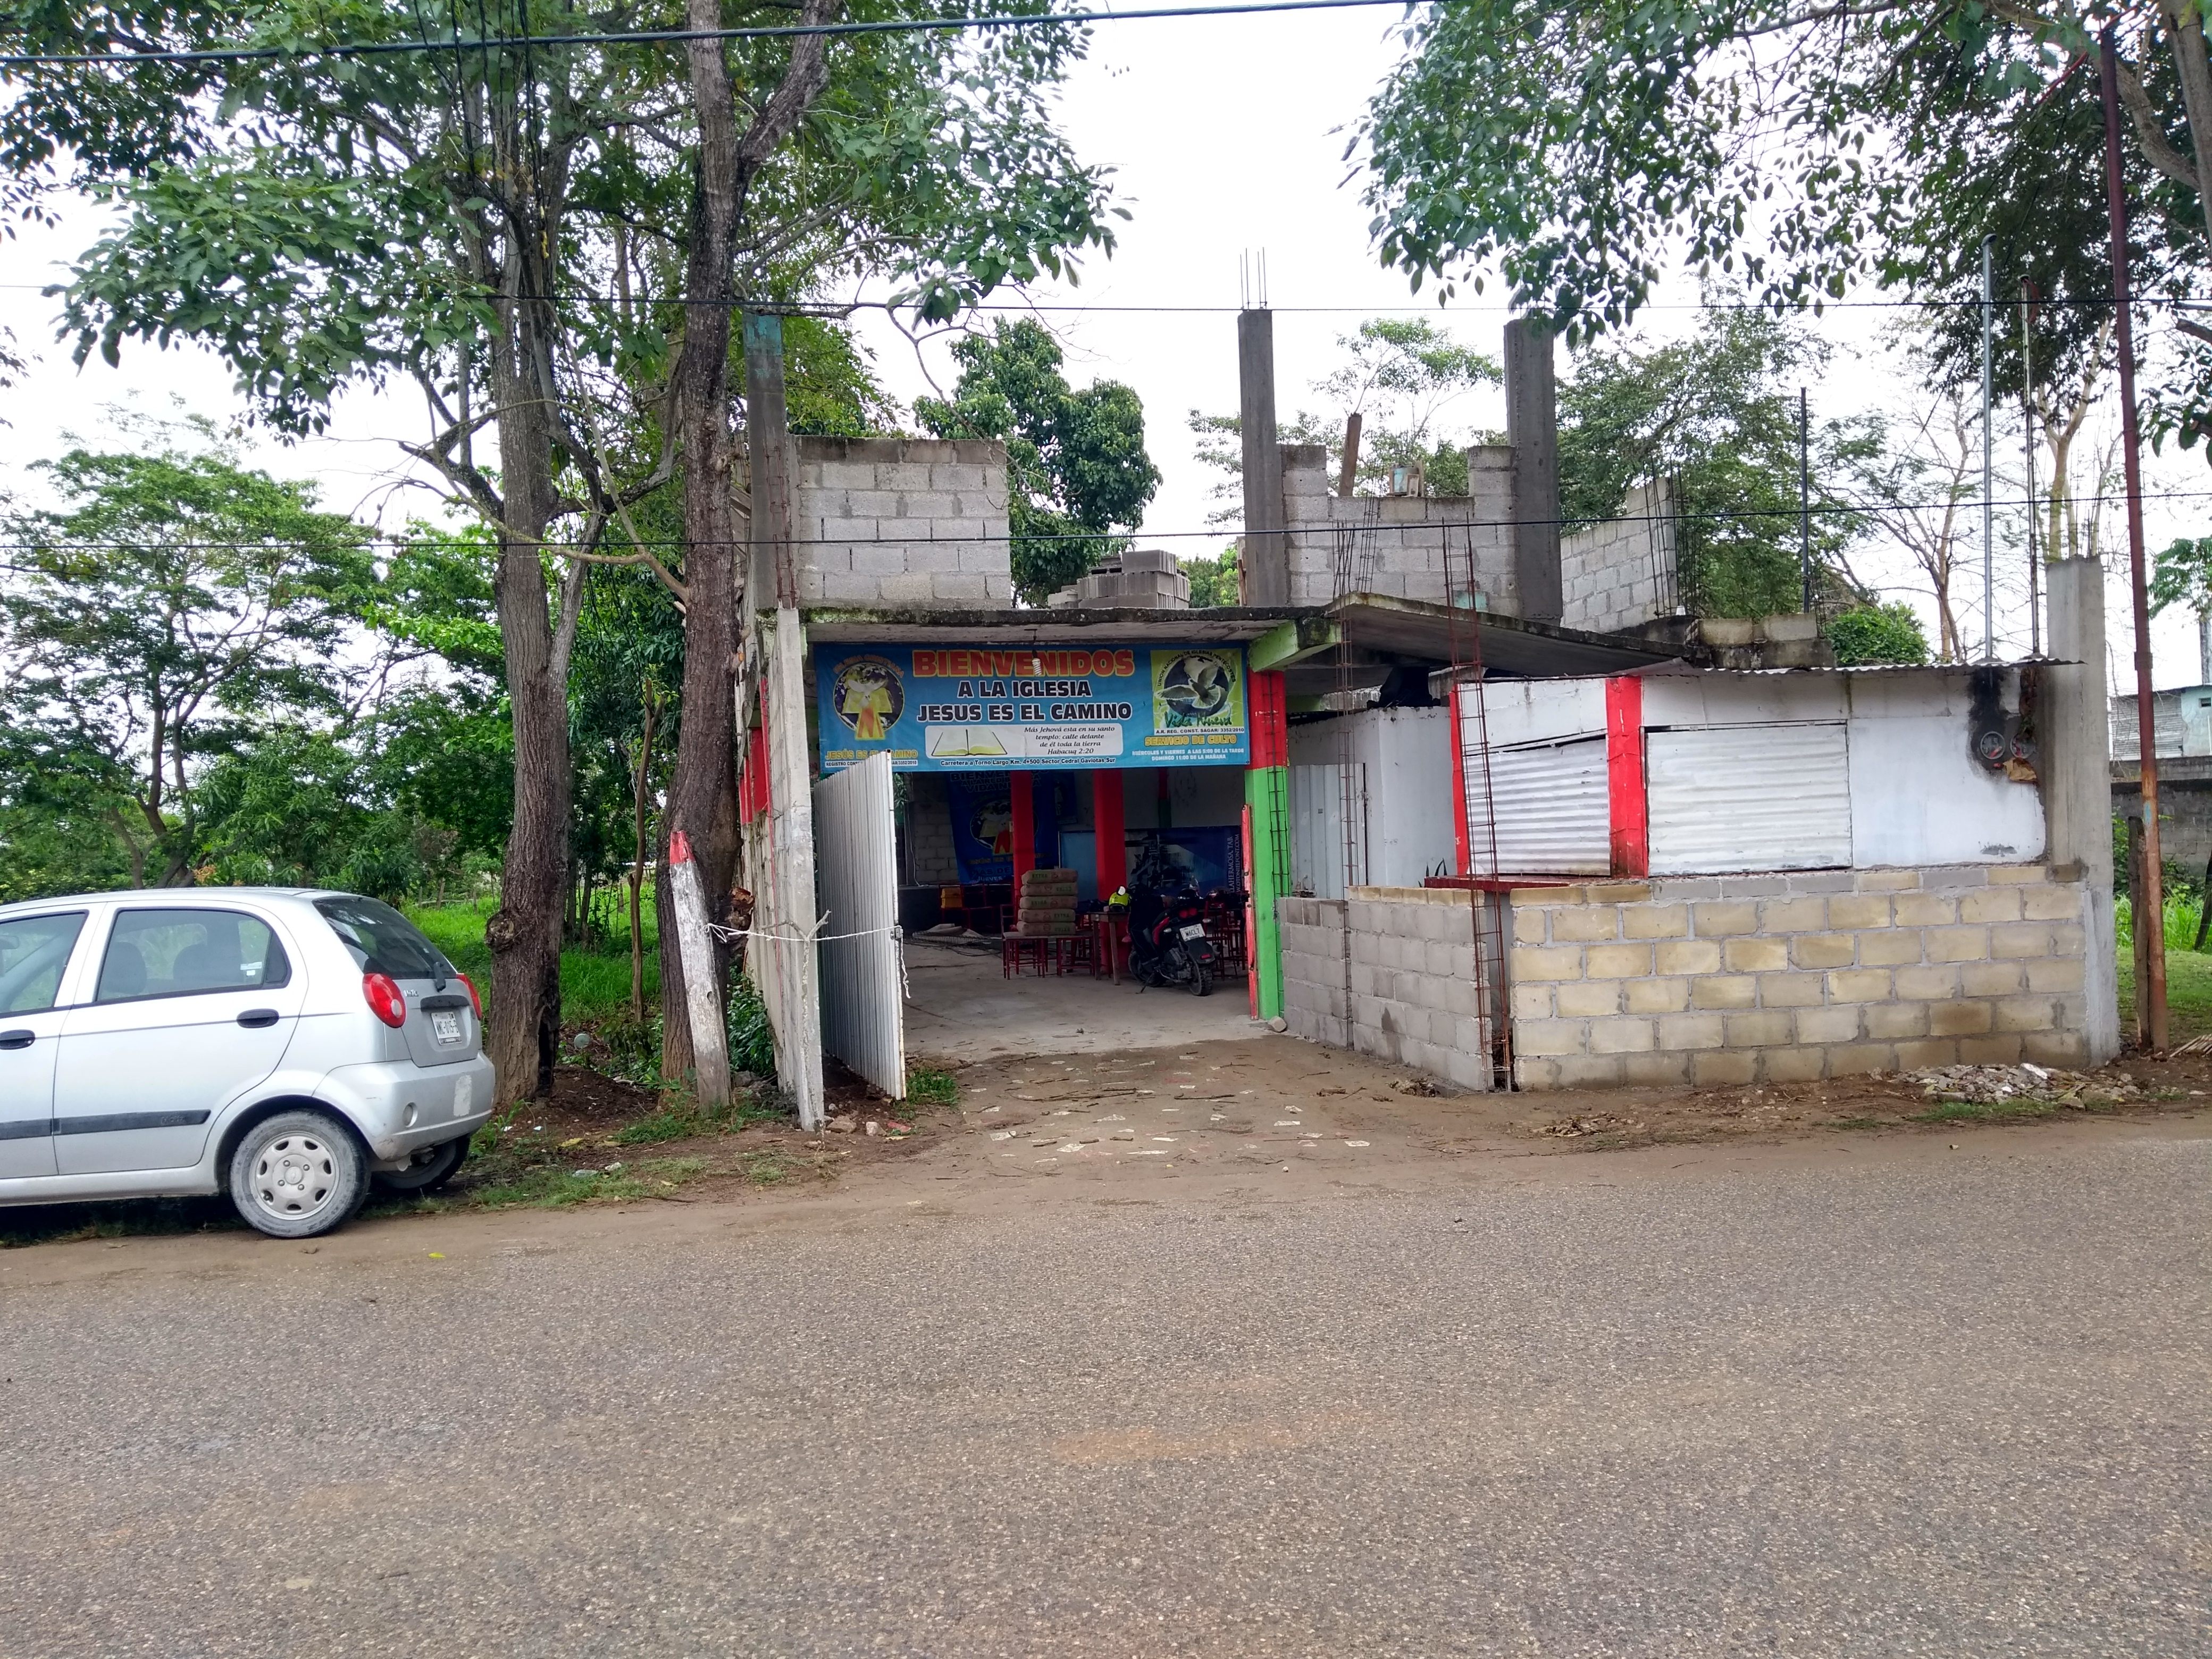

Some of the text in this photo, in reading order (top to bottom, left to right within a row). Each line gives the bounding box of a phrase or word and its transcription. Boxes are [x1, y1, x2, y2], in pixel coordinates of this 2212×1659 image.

[912, 649, 1135, 677] BIENVENIDOS
[1157, 670, 1166, 686] UNION
[1164, 653, 1184, 670] NACIONAL
[957, 680, 1093, 698] A LA IGLESIA
[917, 702, 1133, 722] JESUS ES EL CAMINO
[1144, 734, 1237, 747] SERVICIO DE CULTO
[825, 749, 854, 760] JESÚS
[856, 749, 868, 759] ES
[890, 749, 918, 759] AMINO
